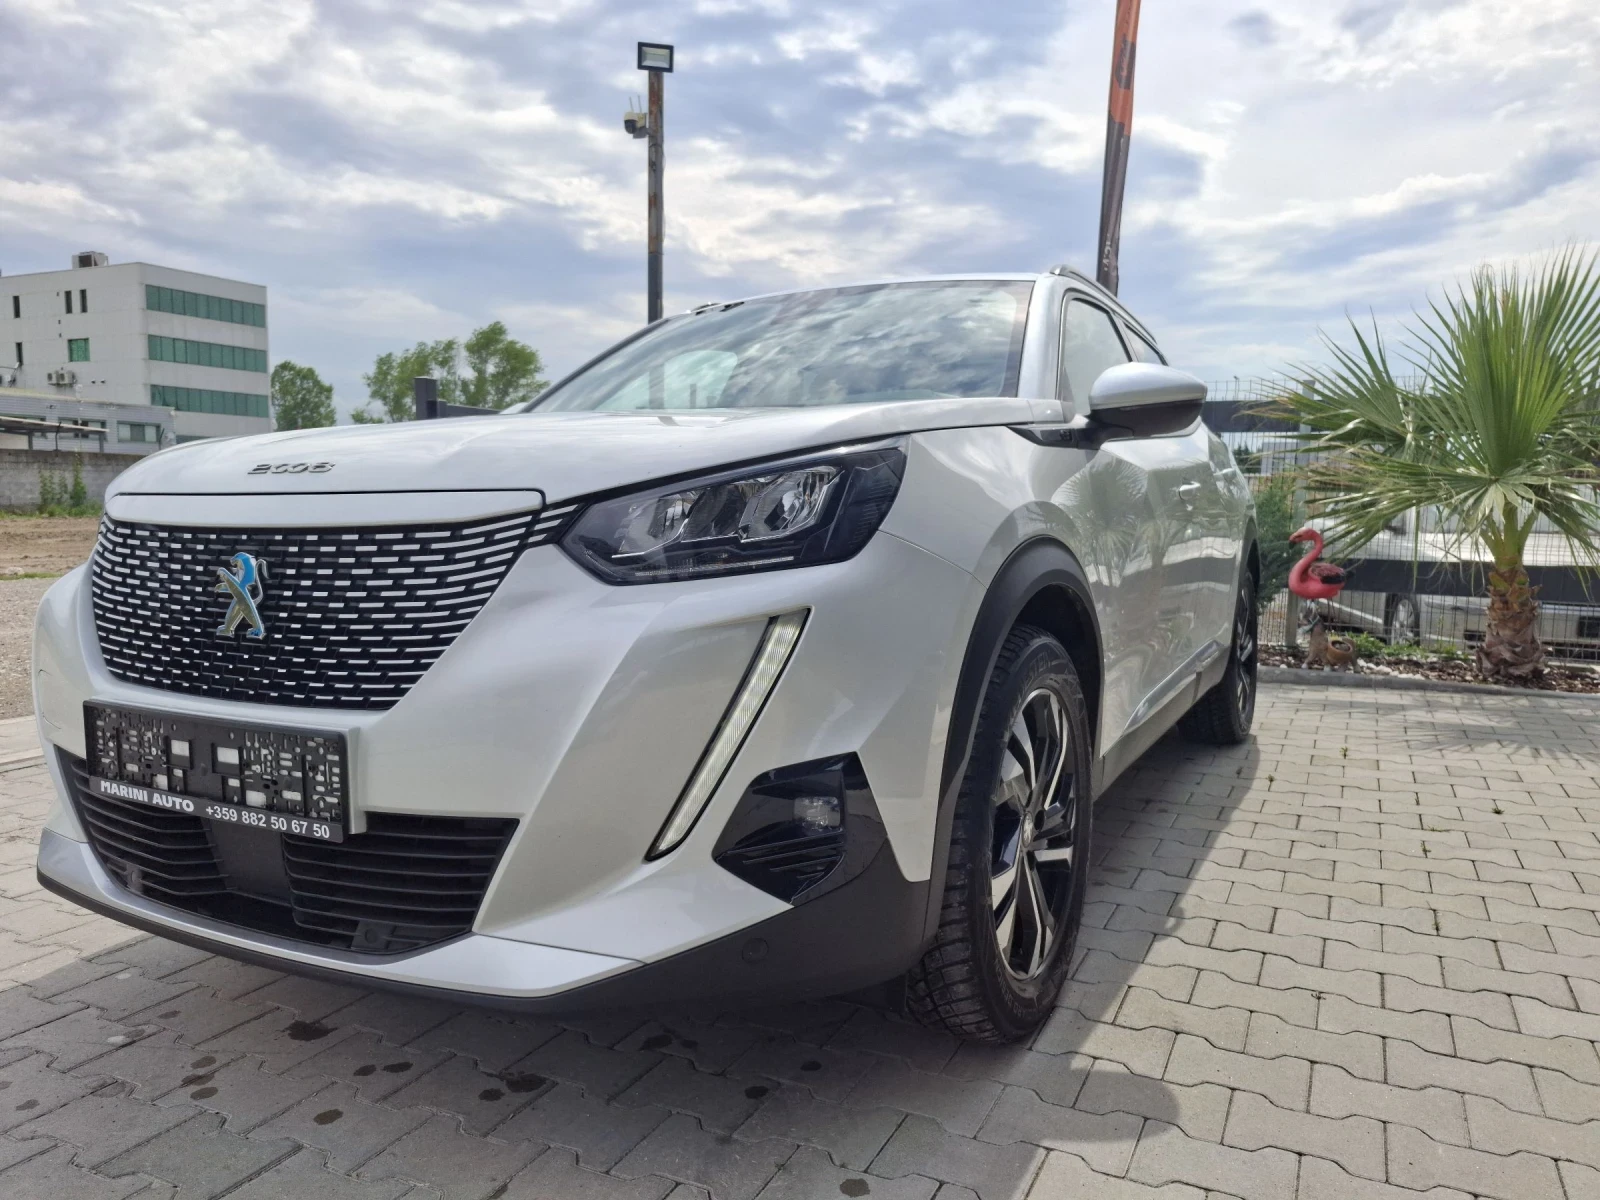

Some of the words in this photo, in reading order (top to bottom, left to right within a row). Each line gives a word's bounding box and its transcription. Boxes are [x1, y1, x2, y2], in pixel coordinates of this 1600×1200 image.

[100, 780, 149, 803] MARINI
[152, 792, 195, 812] AUTO
[206, 806, 238, 821] +359
[241, 810, 267, 827] 882
[270, 816, 287, 831] 50
[291, 819, 308, 834] 67
[313, 823, 330, 839] 50
